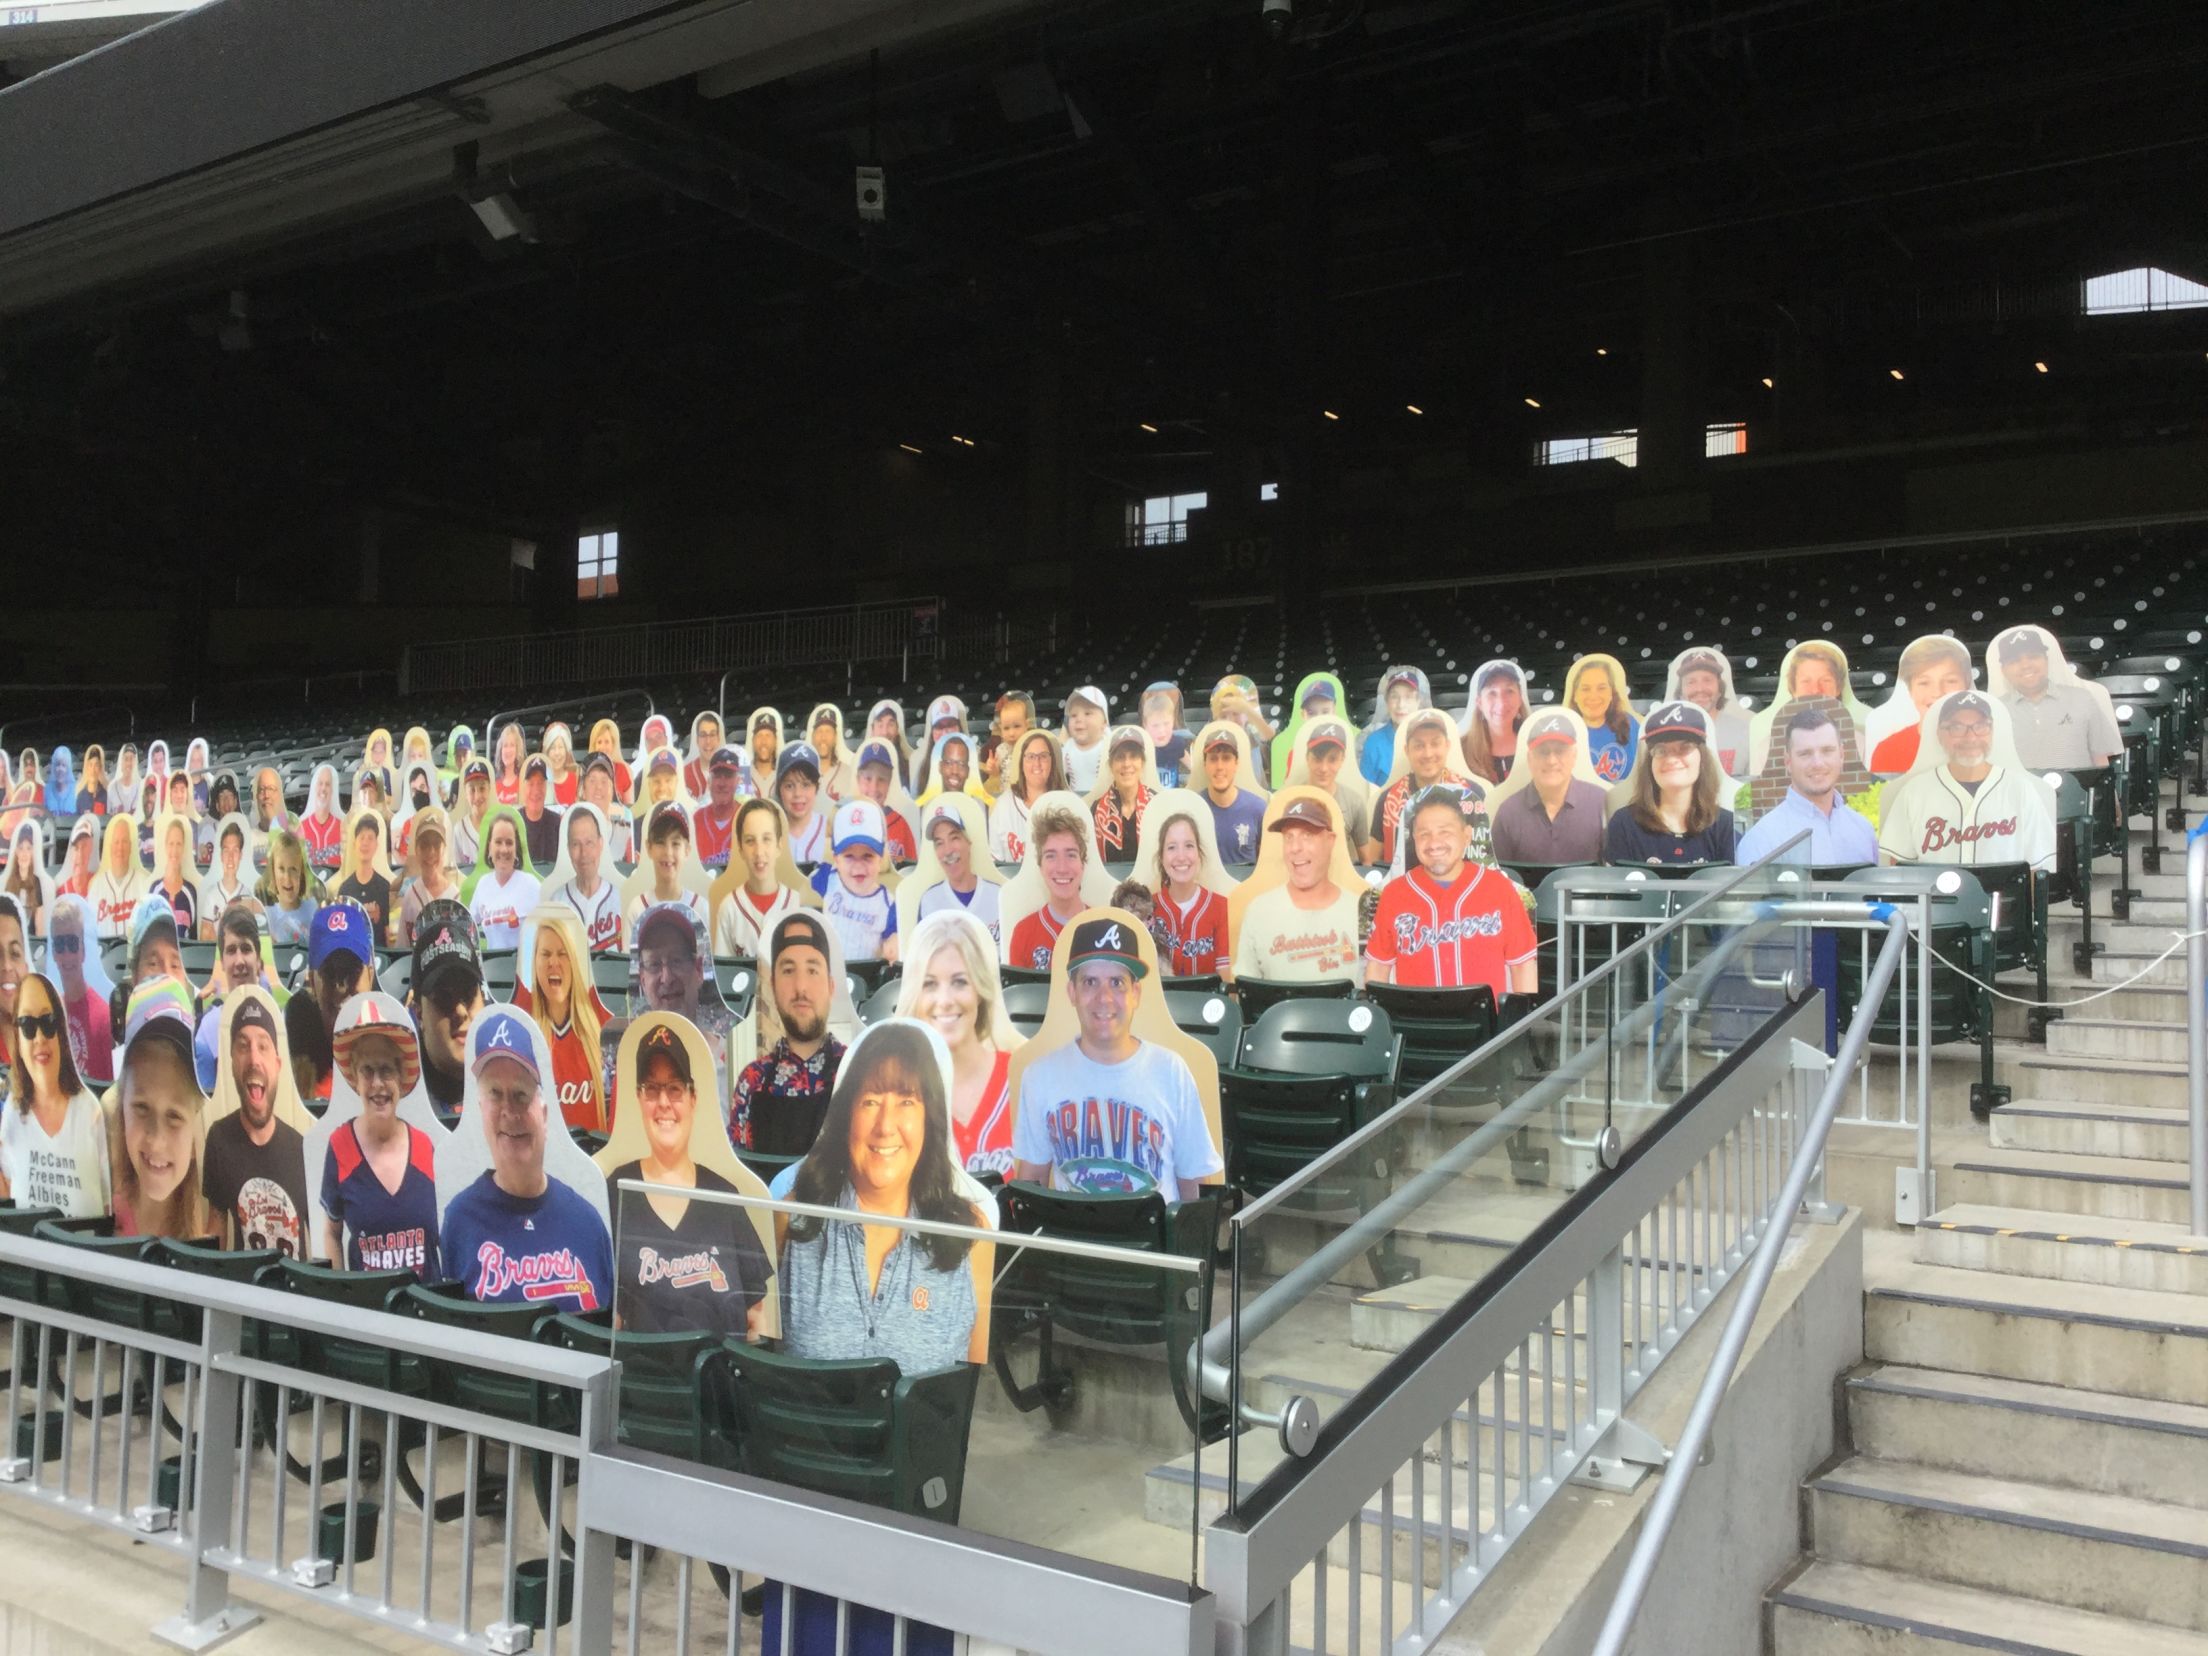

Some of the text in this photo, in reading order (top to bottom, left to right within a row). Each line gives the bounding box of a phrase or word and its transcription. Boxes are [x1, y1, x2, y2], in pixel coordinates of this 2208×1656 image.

[2010, 632, 2027, 644] A
[1958, 694, 1977, 706] A
[1542, 718, 1560, 732] A
[1660, 705, 1683, 725] A
[1214, 730, 1229, 741] A
[1321, 725, 1336, 737] A
[791, 744, 809, 758] A
[470, 762, 480, 773] A
[1288, 803, 1303, 814] A
[1922, 815, 2018, 854] Braves
[829, 892, 877, 926] Braves
[1095, 924, 1121, 950] A
[1395, 909, 1501, 956] Braves
[488, 1020, 512, 1048] A
[648, 1026, 671, 1046] A
[1046, 1096, 1166, 1179] BRAVES
[30, 1150, 76, 1170] McCann
[28, 1167, 82, 1190] Freeman
[28, 1185, 69, 1207] Albies
[358, 1227, 425, 1252] ATLANTA
[362, 1245, 425, 1270] BRAVES
[639, 1247, 710, 1285] Braves
[475, 1241, 574, 1301] Braves
